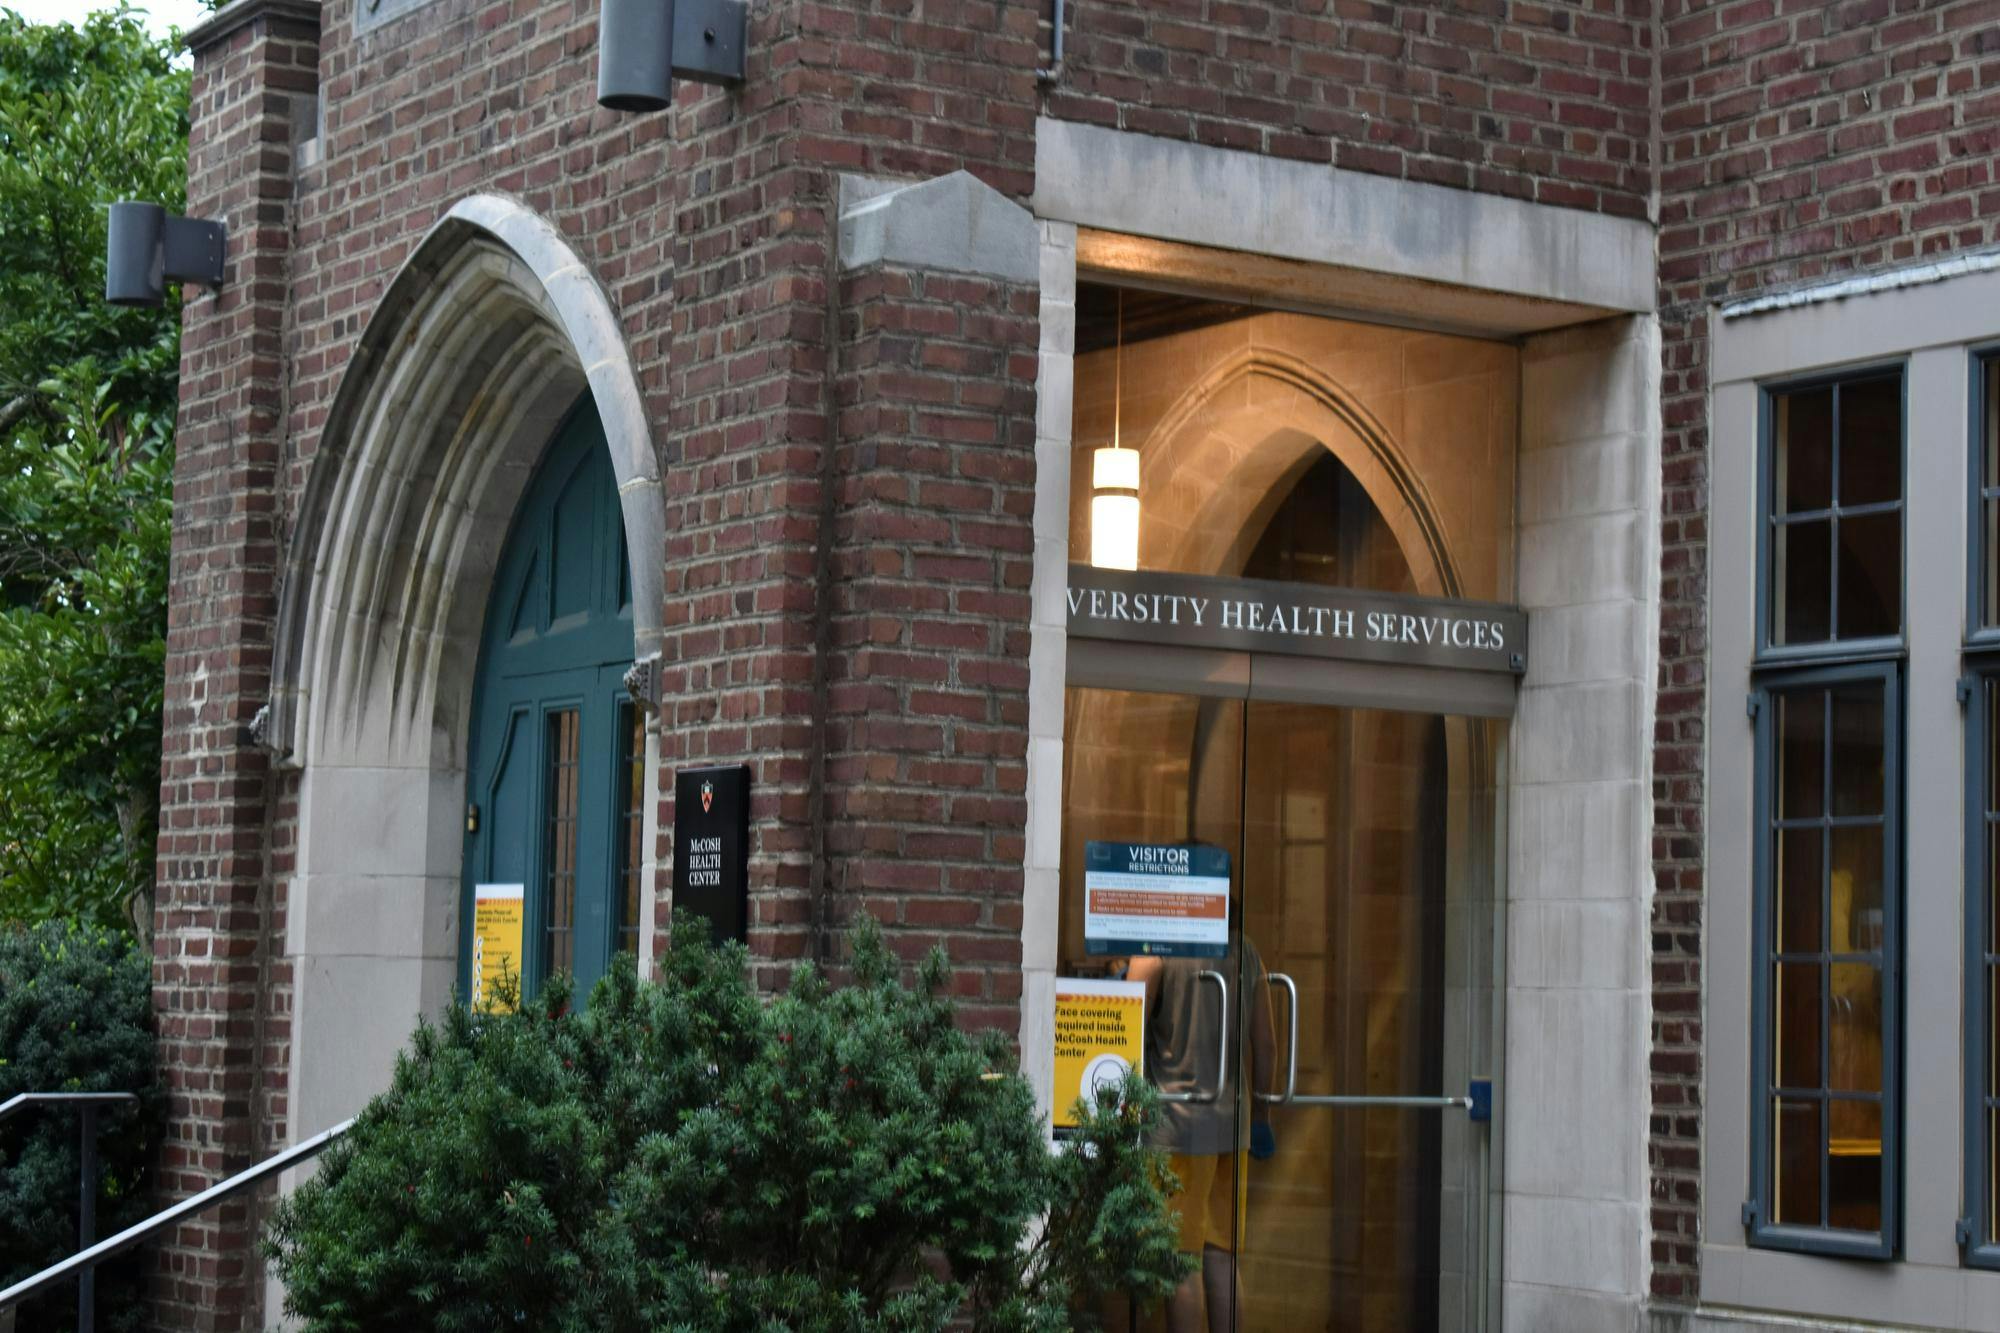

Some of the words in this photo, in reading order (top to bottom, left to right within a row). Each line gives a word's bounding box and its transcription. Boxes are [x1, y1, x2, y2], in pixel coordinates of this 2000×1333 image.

[1221, 600, 1355, 639] HEALTH
[1366, 612, 1505, 651] SERVICES
[690, 837, 721, 853] McCOSH
[689, 854, 721, 869] HEALTH
[1129, 846, 1189, 864] VISITOR
[1129, 862, 1189, 874] RESTRICTIONS
[689, 870, 720, 886] CENTER
[1080, 1008, 1121, 1021] covering
[1097, 1021, 1126, 1032] inside
[1055, 1033, 1093, 1044] McCosh
[1096, 1035, 1127, 1046] Health
